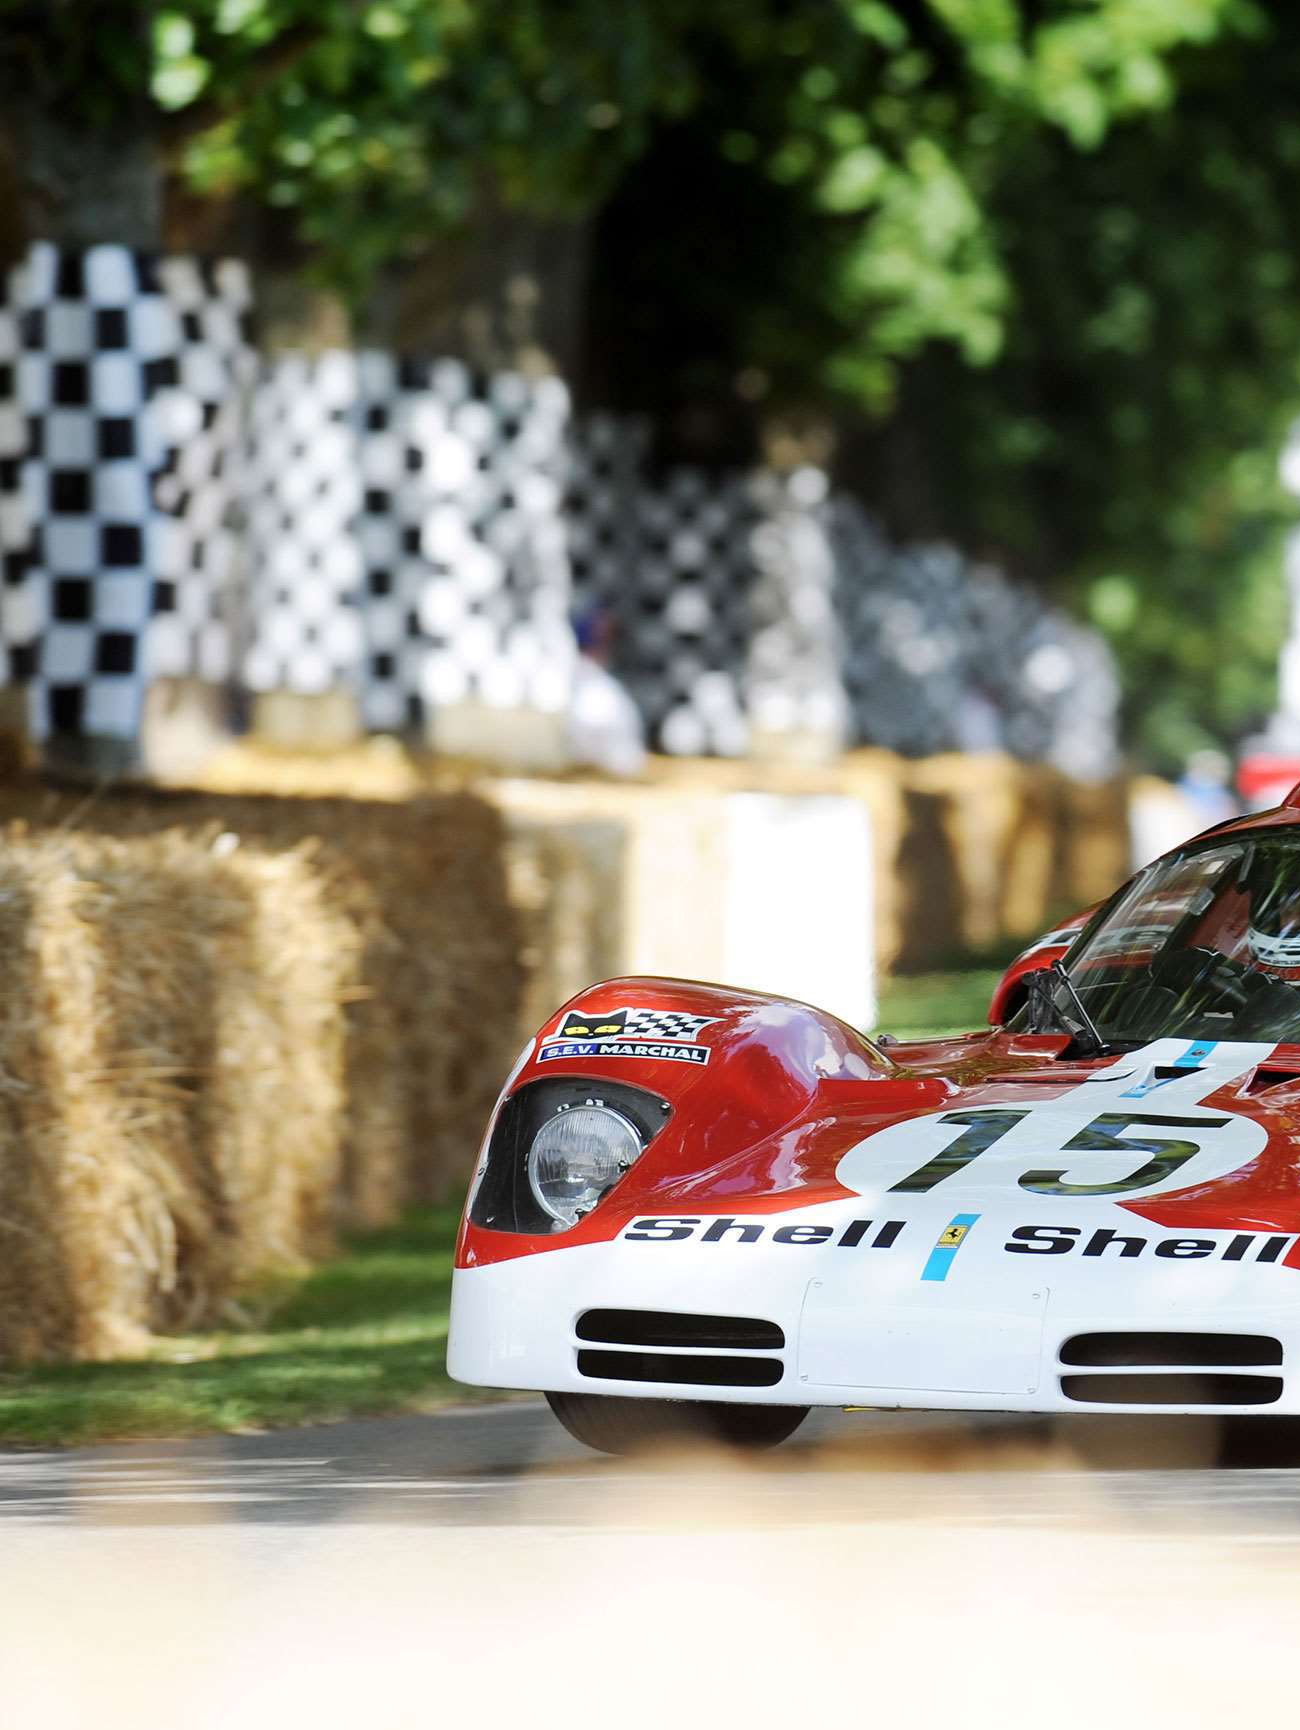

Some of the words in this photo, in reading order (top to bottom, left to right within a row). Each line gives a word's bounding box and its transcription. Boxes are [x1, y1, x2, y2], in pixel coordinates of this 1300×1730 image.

[546, 1044, 594, 1057] S.E.V.
[599, 1044, 703, 1061] MARCHAL
[886, 1109, 1234, 1197] 15
[624, 1218, 907, 1249] Shell
[1003, 1225, 1292, 1263] Shell
